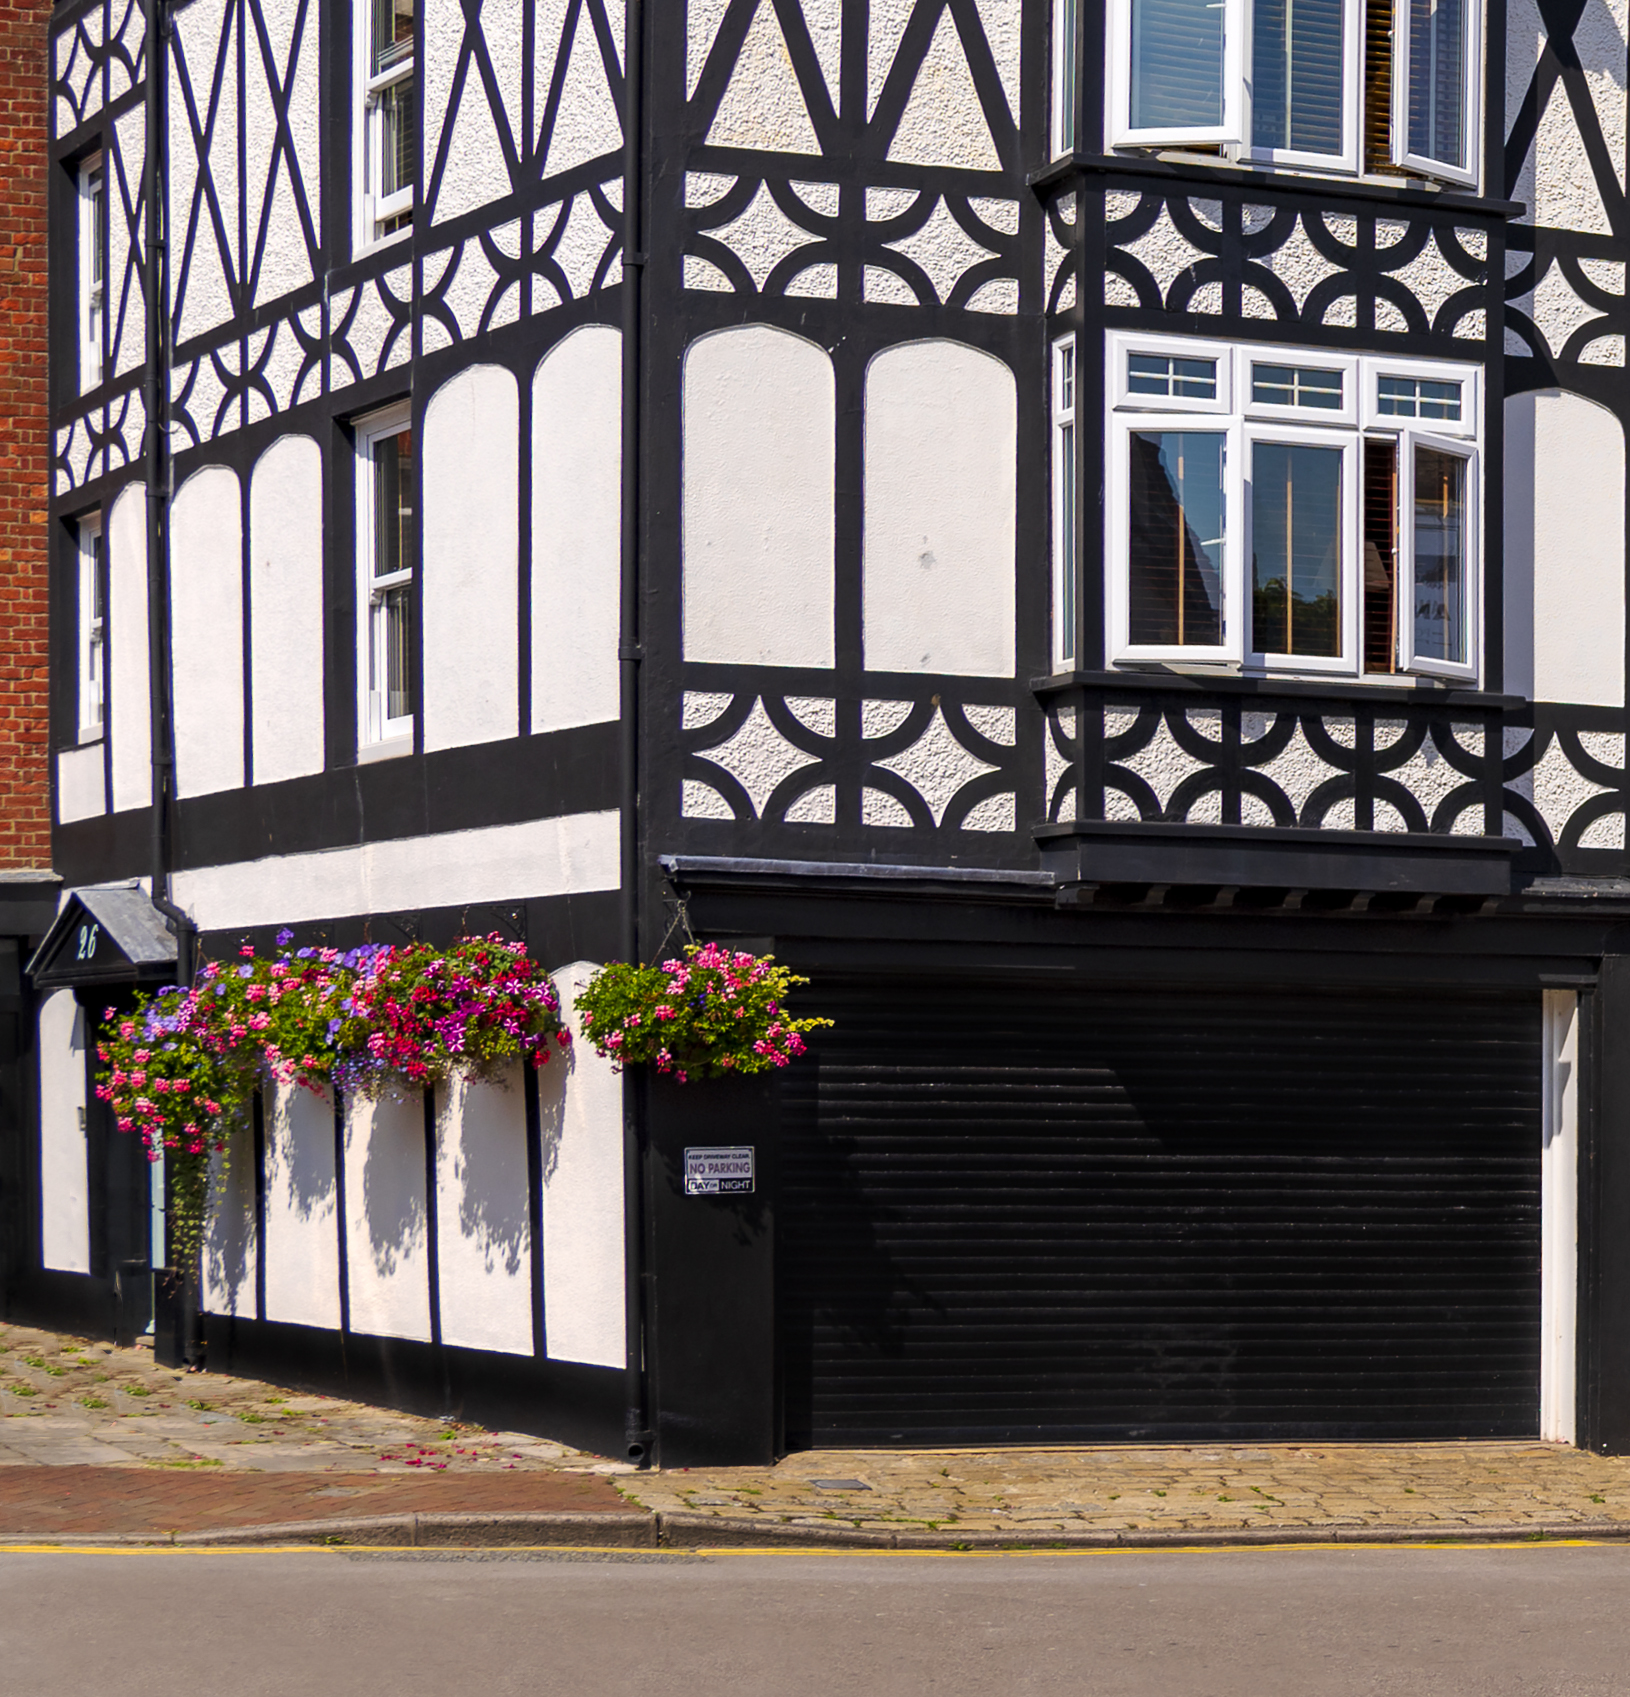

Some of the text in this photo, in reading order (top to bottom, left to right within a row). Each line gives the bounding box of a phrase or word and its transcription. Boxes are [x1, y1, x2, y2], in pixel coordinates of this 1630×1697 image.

[77, 923, 99, 960] 26
[690, 1162, 750, 1174] NO PARKING
[721, 1180, 750, 1189] NIGHT
